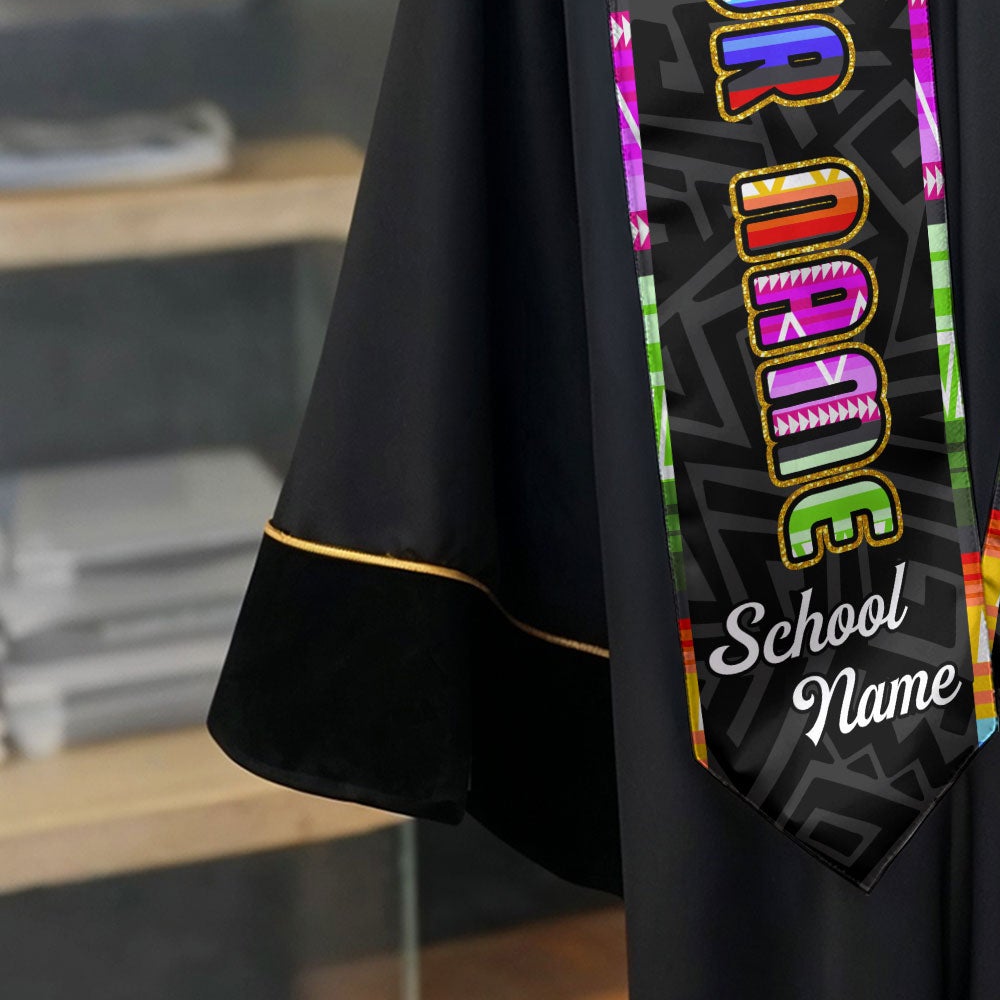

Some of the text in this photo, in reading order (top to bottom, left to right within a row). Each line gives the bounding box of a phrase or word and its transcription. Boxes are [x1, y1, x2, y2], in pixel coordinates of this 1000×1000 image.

[726, 156, 904, 570] NAME
[709, 562, 908, 676] School
[792, 664, 963, 748] Name
